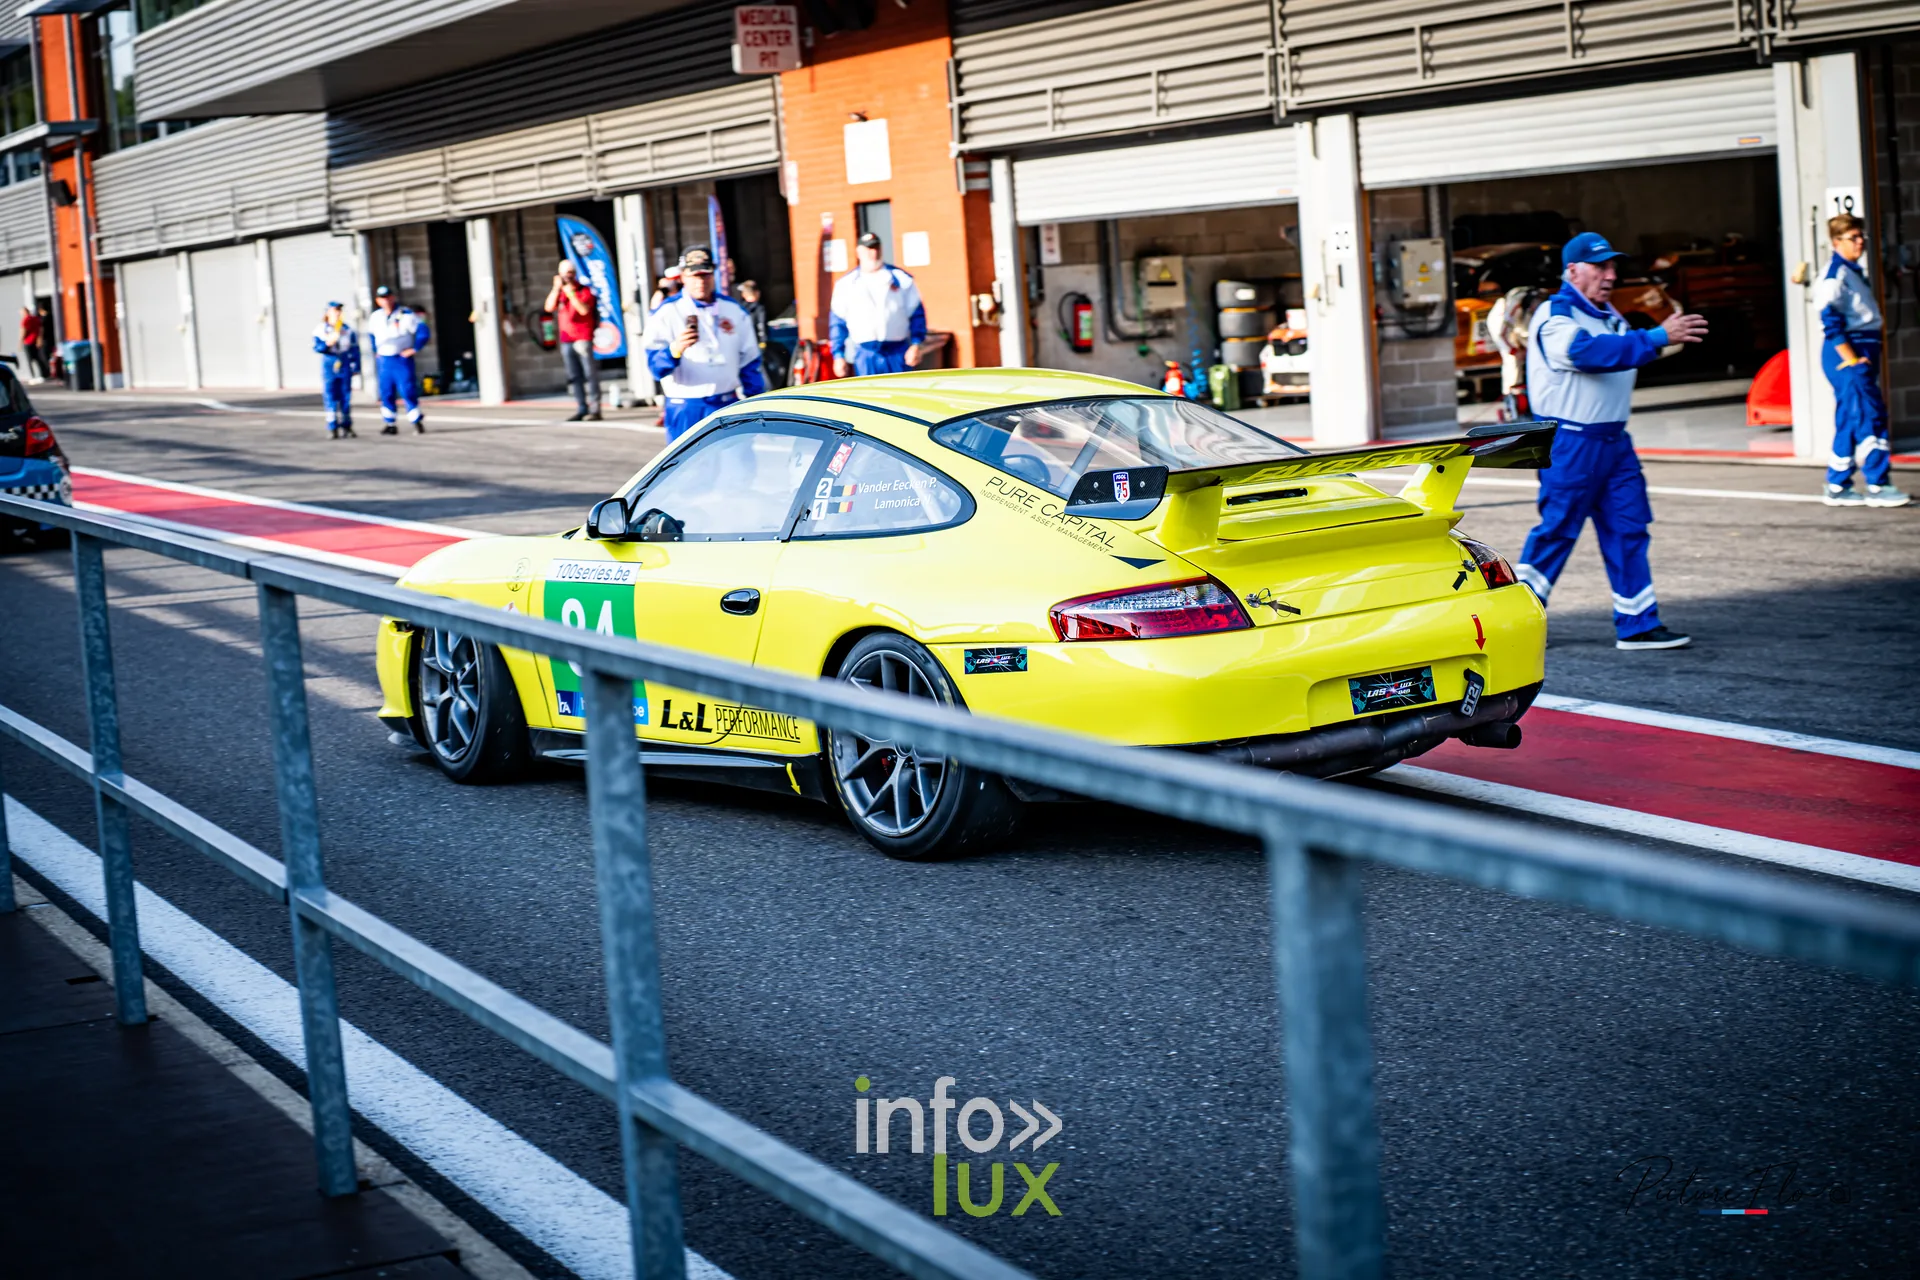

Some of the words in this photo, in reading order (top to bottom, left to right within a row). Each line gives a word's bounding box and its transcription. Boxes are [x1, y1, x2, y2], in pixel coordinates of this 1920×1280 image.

[740, 9, 794, 26] MEDICAL
[744, 29, 793, 47] CENTER
[759, 51, 778, 68] PIT
[820, 481, 829, 497] 2
[858, 481, 892, 494] Vander
[893, 478, 927, 491] Eecken
[929, 477, 937, 489] P.
[1116, 482, 1128, 498] 75
[874, 496, 921, 510] Lamonica
[980, 488, 1029, 516] INDEPENDENT
[1030, 513, 1056, 529] ASSET
[1056, 526, 1110, 554] MANAGEMENT
[986, 476, 1041, 508] PURE
[1040, 503, 1116, 549] CAPITAL
[556, 563, 631, 582] 100series.be
[1367, 687, 1387, 698] LAS
[660, 699, 713, 733] L&L
[715, 707, 801, 741] PERFORMANCE
